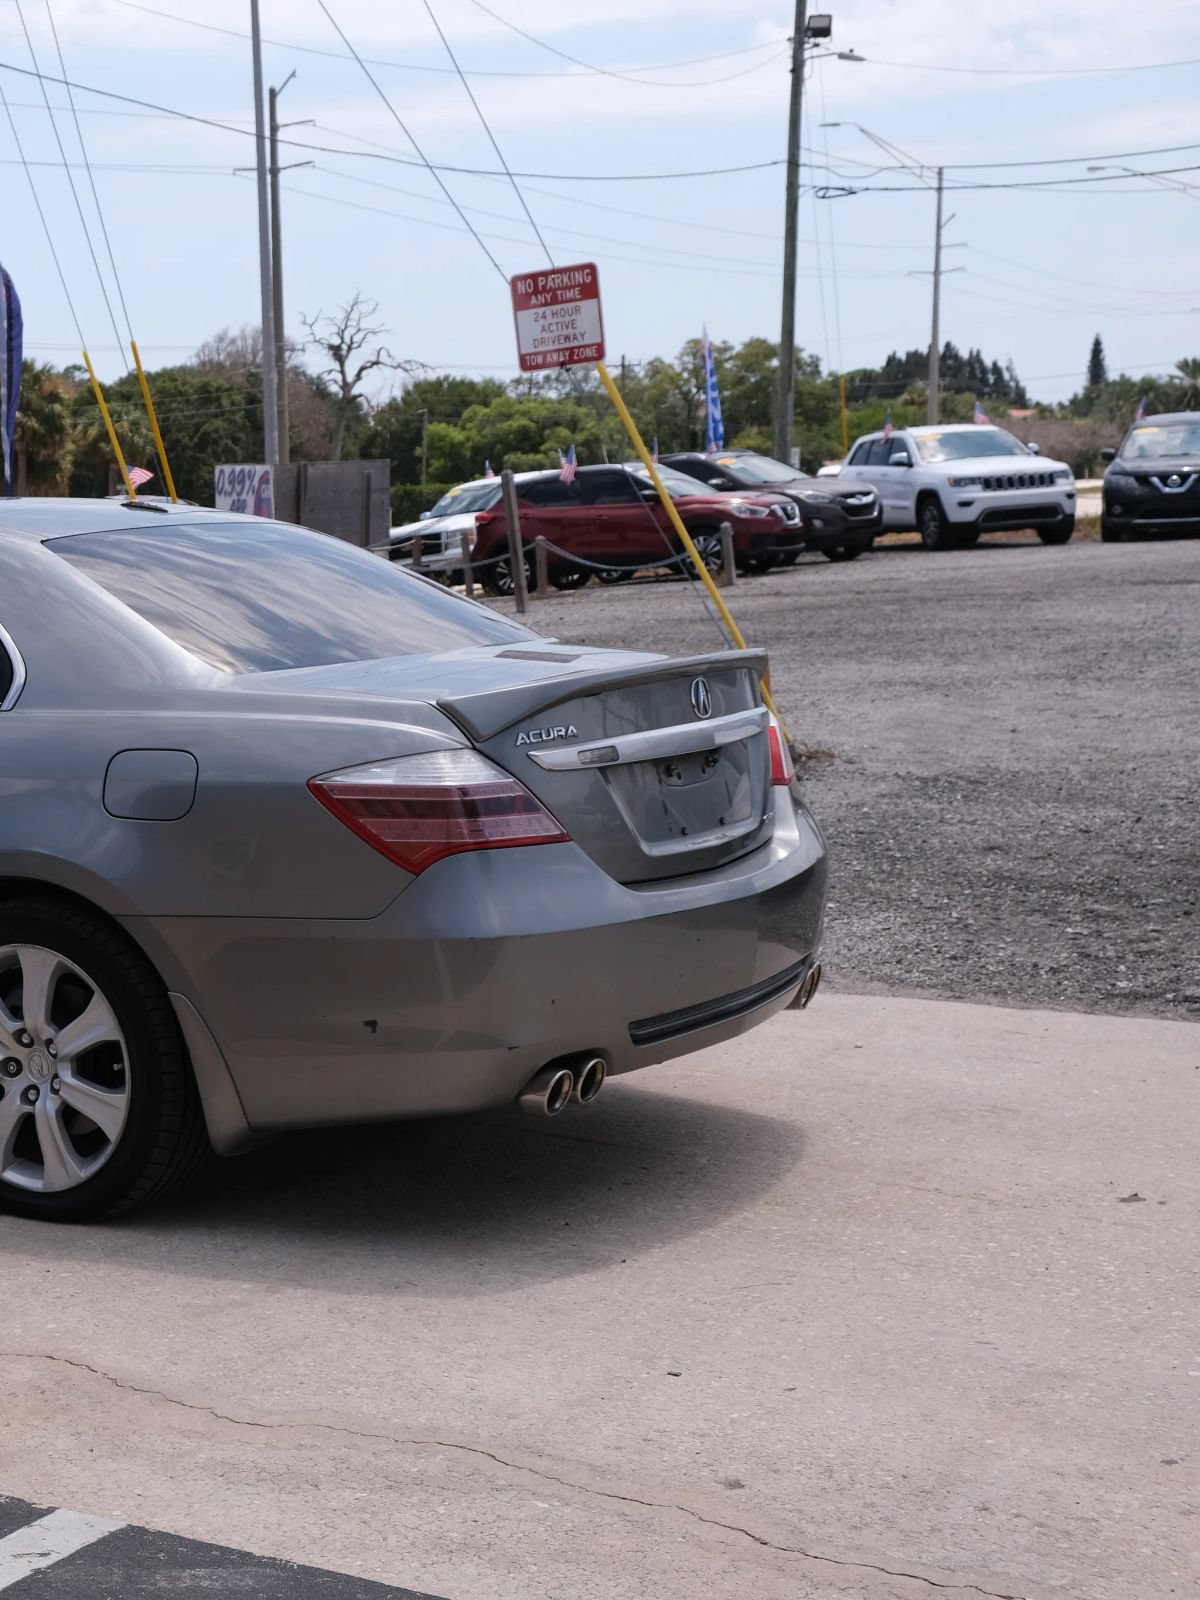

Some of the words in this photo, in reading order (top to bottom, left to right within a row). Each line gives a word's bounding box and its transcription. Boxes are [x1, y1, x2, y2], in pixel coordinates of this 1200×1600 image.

[517, 279, 534, 294] NO
[538, 269, 592, 290] PARKING
[530, 292, 553, 305] ANY
[557, 287, 582, 300] TIME
[533, 311, 547, 322] 24
[551, 305, 582, 319] HOUR
[541, 319, 578, 334] ACTIVE
[533, 331, 586, 349] DRIVEWAY
[525, 355, 543, 366] TOW
[546, 351, 571, 362] AWAY
[573, 346, 598, 359] ZONE
[216, 468, 256, 497] 0.99%
[515, 724, 578, 746] ACURA
